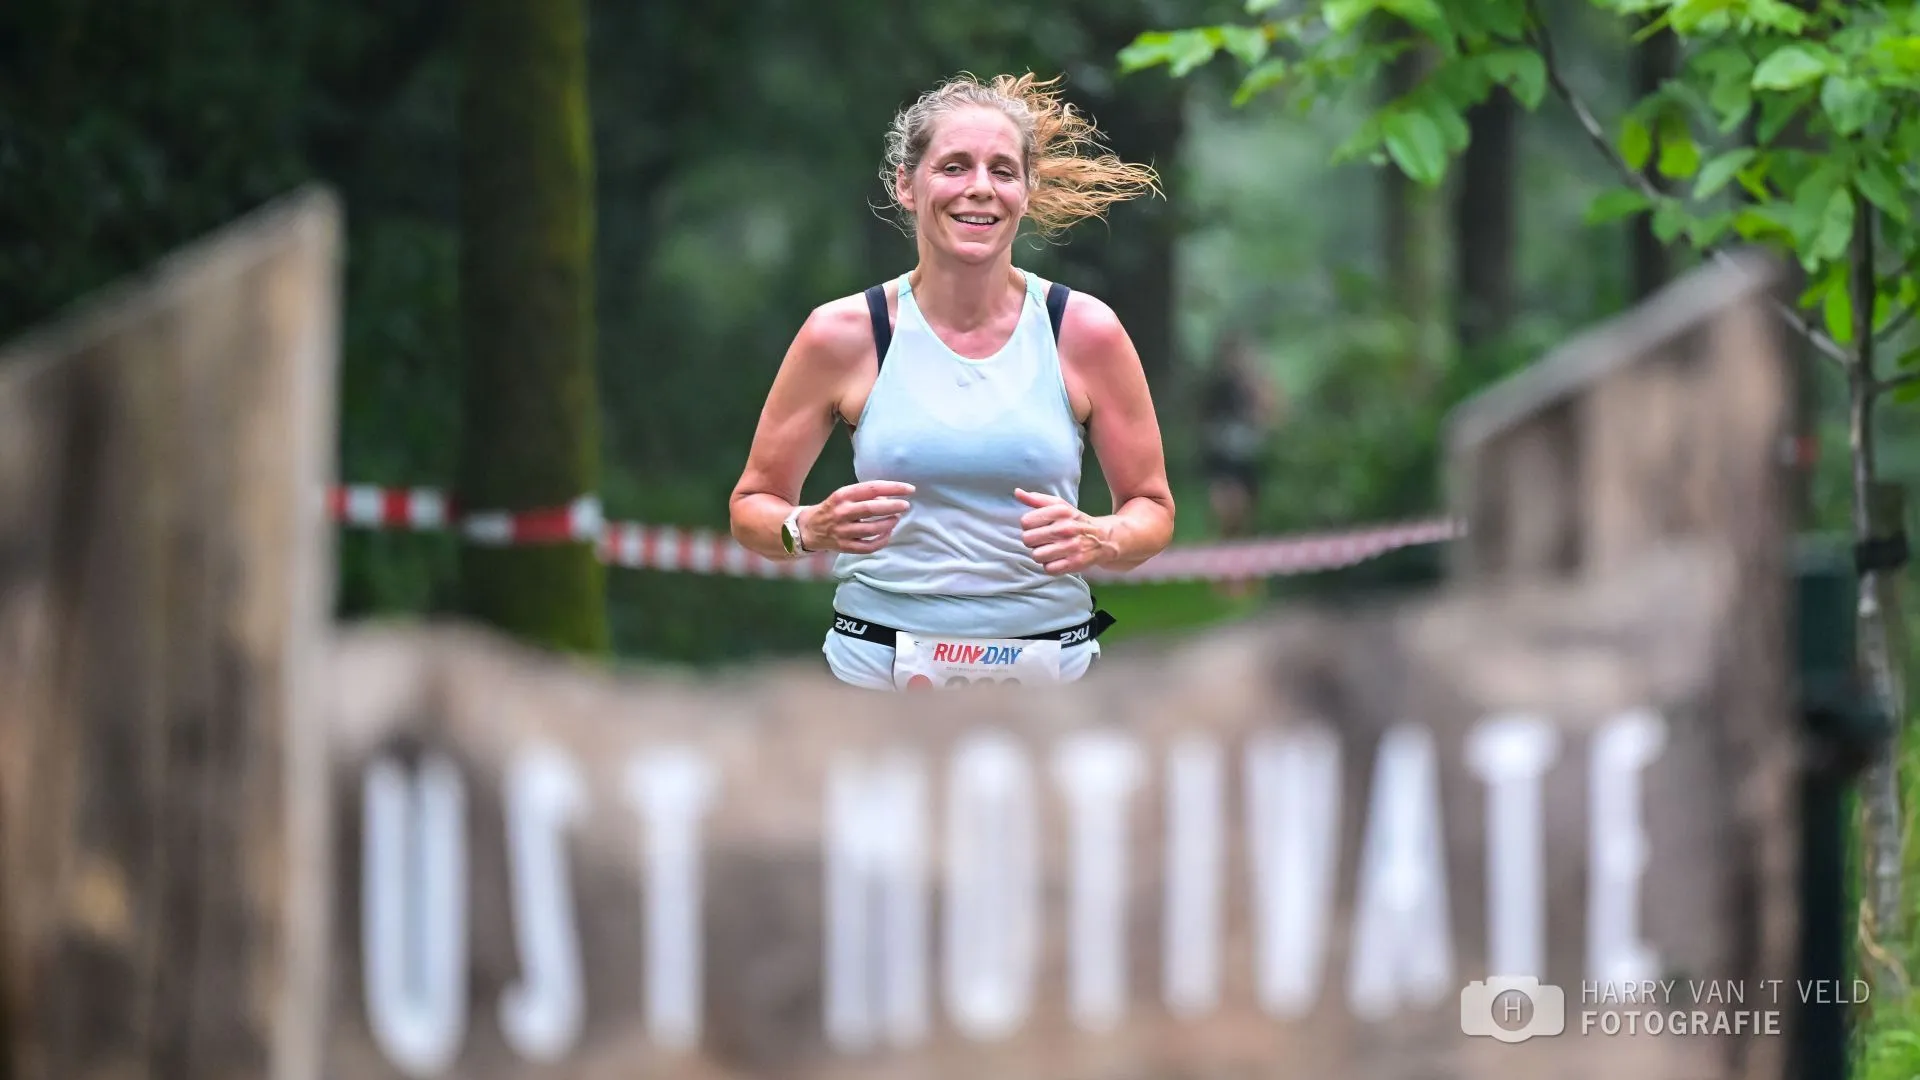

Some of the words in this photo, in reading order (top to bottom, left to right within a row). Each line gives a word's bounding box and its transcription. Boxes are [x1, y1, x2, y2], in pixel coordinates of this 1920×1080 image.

[835, 617, 868, 635] 2XU
[1060, 625, 1089, 645] 2XU
[823, 712, 1666, 1053] MOTIVATE
